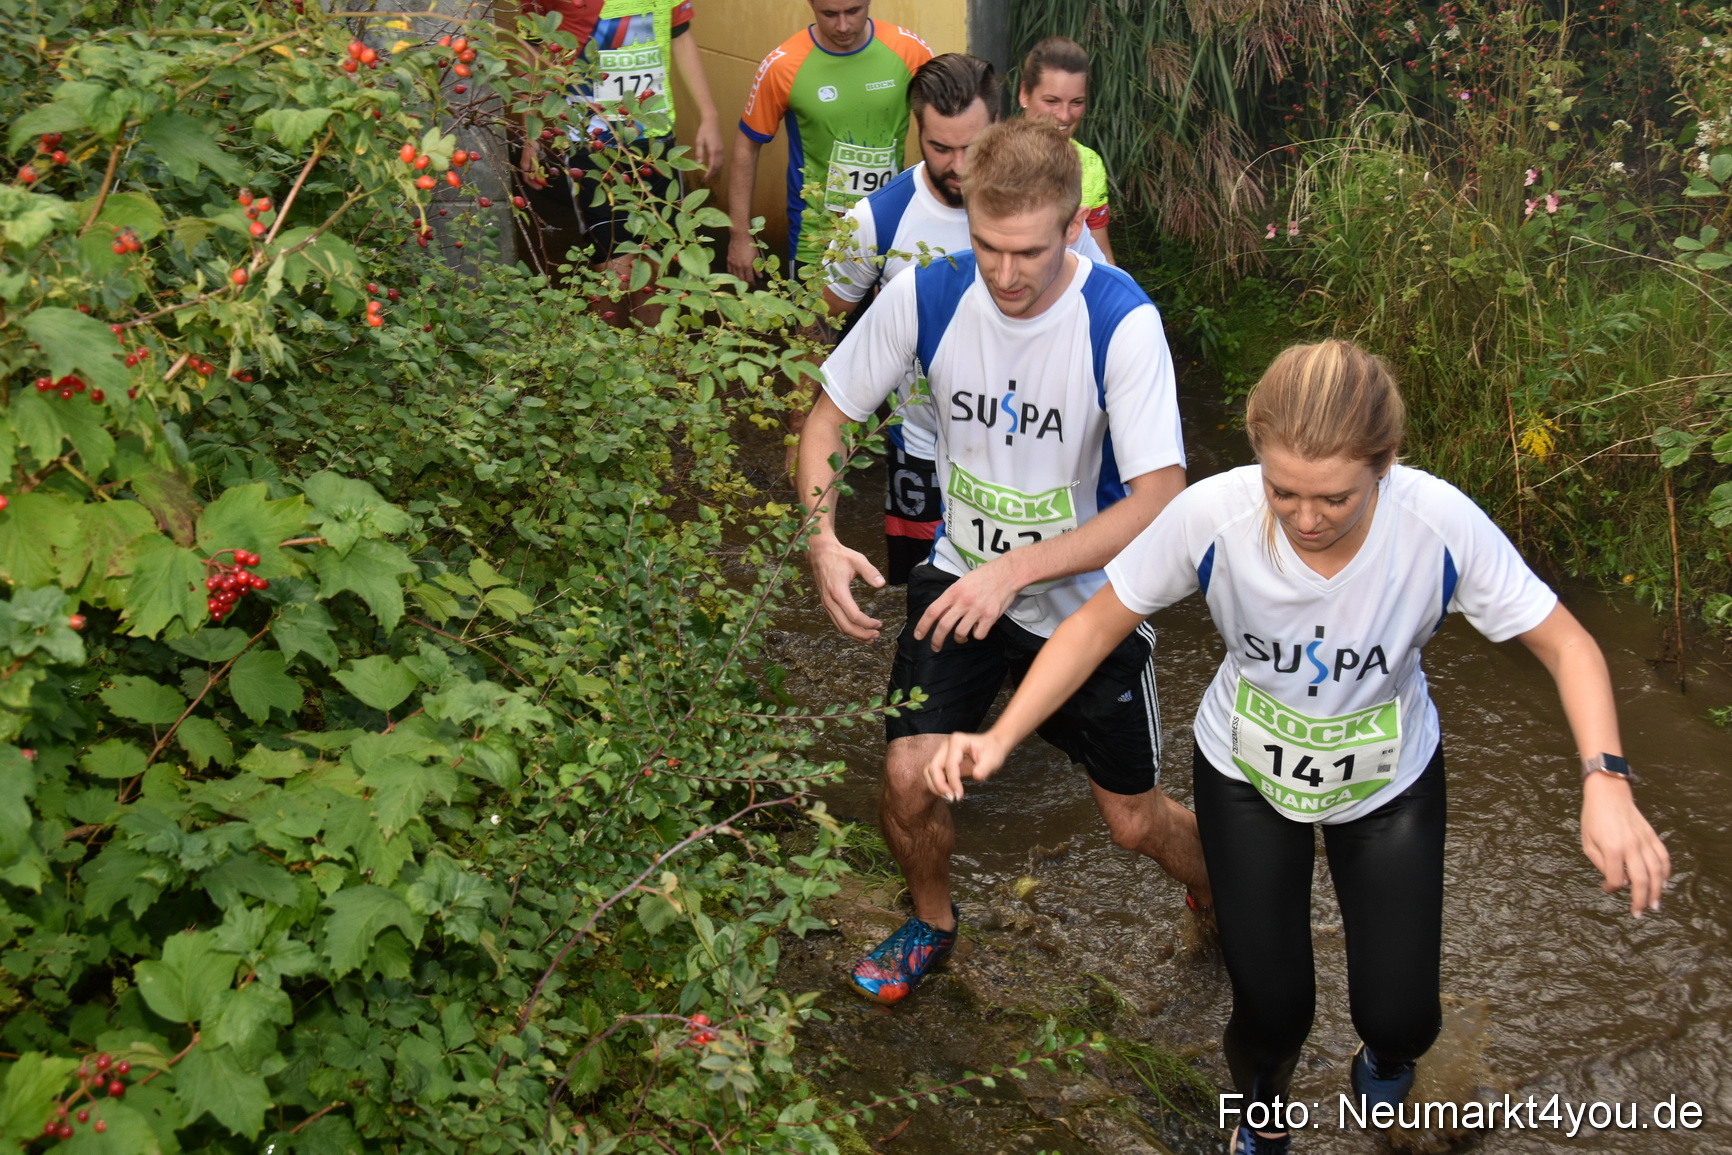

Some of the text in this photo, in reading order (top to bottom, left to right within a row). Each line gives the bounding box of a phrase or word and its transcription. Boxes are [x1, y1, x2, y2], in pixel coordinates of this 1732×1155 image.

[601, 51, 660, 69] BOCK
[613, 73, 654, 96] 172
[865, 79, 896, 91] BOCK
[848, 170, 892, 192] 190
[951, 380, 1064, 446] SUSPA
[954, 467, 1063, 522] BOCK
[1244, 626, 1389, 697] SUSPA
[1246, 690, 1386, 746] BOCK
[1263, 744, 1355, 787] 141
[1261, 778, 1353, 810] BIANCA
